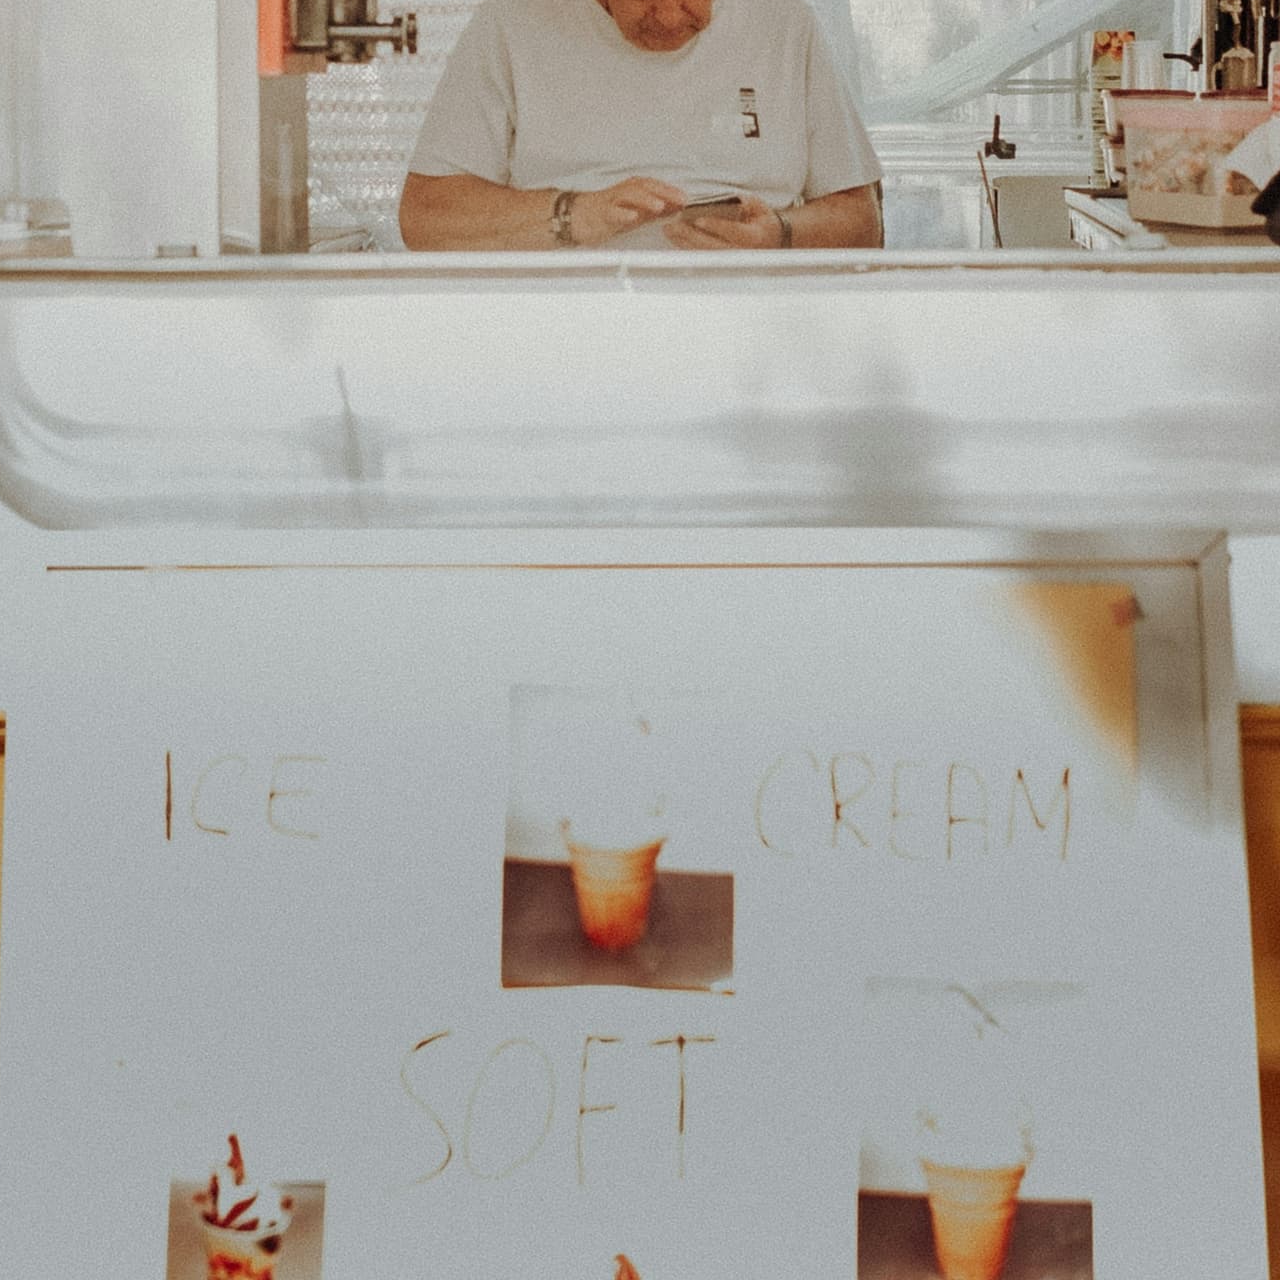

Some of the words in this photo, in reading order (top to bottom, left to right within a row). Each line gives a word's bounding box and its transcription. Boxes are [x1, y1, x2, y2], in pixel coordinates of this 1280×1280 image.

[165, 749, 328, 842] ICE
[754, 743, 1071, 862] CREAM
[392, 1030, 718, 1188] SOFT
